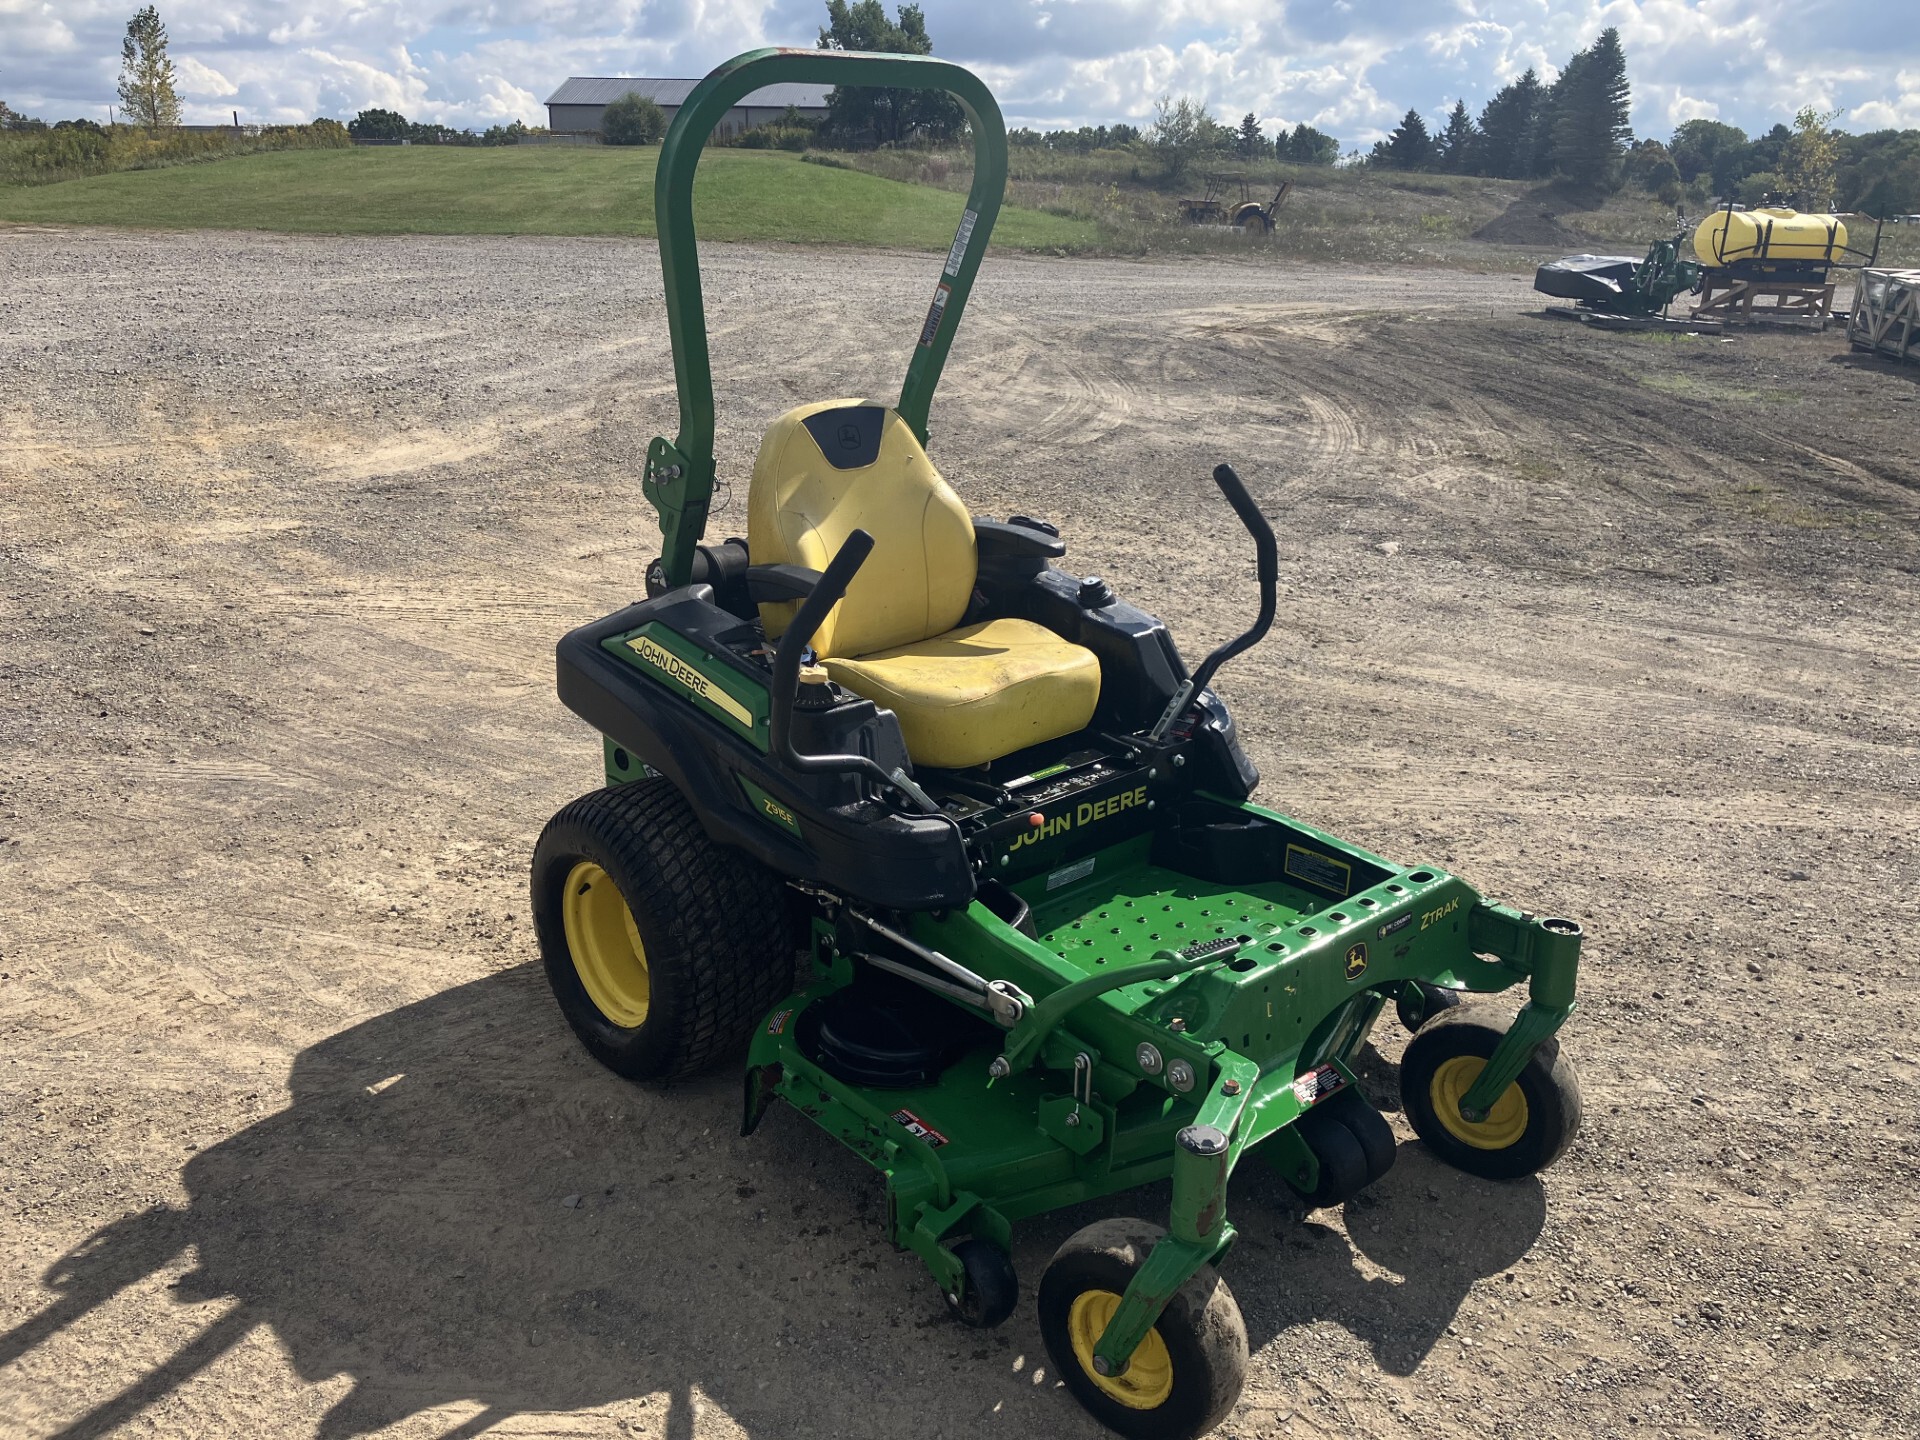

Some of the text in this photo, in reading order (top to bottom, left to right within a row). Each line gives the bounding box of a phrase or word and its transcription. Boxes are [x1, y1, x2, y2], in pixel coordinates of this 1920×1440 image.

[636, 640, 709, 695] JOHN DEERE
[763, 799, 794, 826] Z915E
[1077, 786, 1147, 826] DEERE
[1420, 897, 1460, 931] ZTRAK
